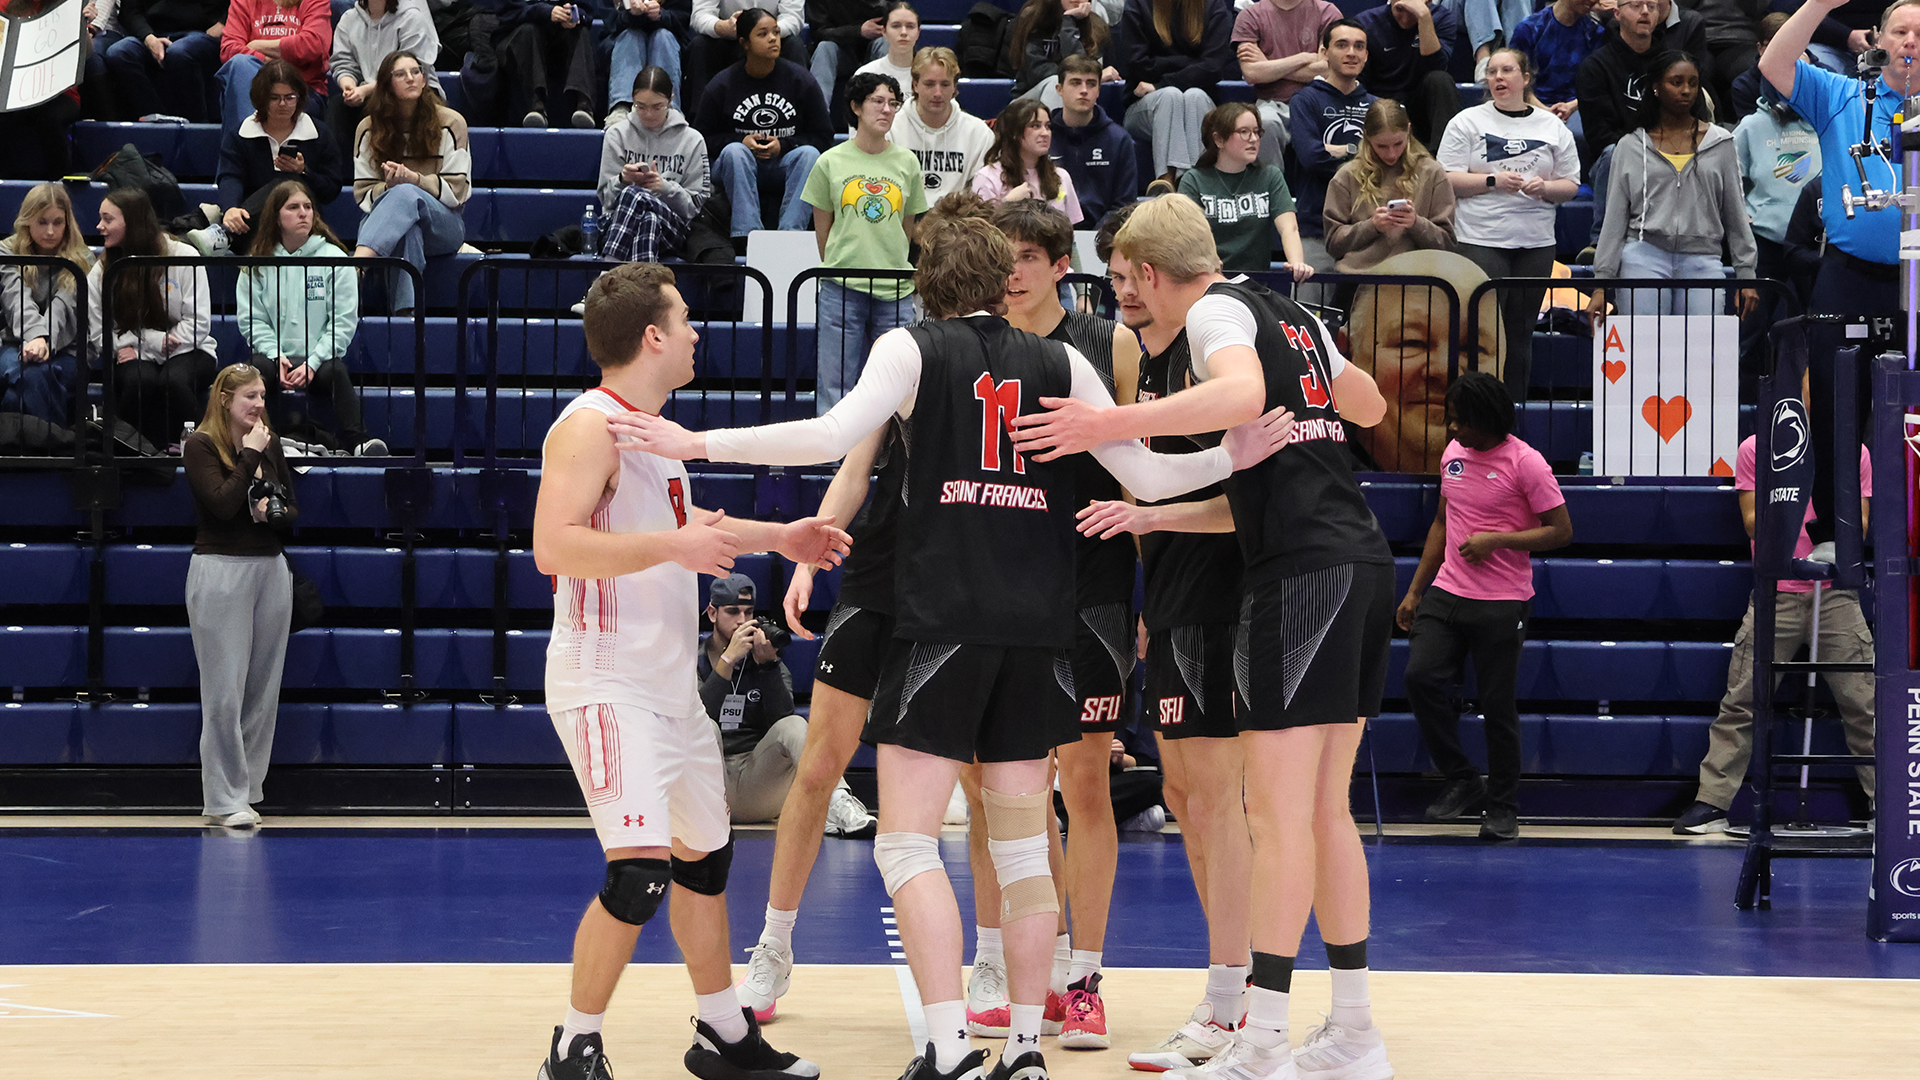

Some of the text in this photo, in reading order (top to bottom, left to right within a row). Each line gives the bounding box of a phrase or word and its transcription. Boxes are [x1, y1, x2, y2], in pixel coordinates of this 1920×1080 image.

[38, 9, 60, 31] LETS
[273, 14, 301, 26] FRANCI
[34, 29, 57, 54] GO
[19, 59, 55, 102] COLE
[733, 92, 797, 123] PENN STATE
[773, 126, 796, 138] LIONS
[933, 150, 964, 174] STATE
[1514, 153, 1541, 173] ACADEMY
[1201, 195, 1269, 220] THON
[1602, 324, 1626, 353] A
[973, 371, 1026, 475] 11
[1288, 419, 1328, 444] SAINT
[940, 479, 982, 504] SAINT
[1774, 487, 1800, 502] STATE
[722, 708, 742, 717] PSU
[1080, 694, 1121, 722] SFU
[1159, 696, 1185, 725] SFU
[1891, 912, 1917, 921] sports
